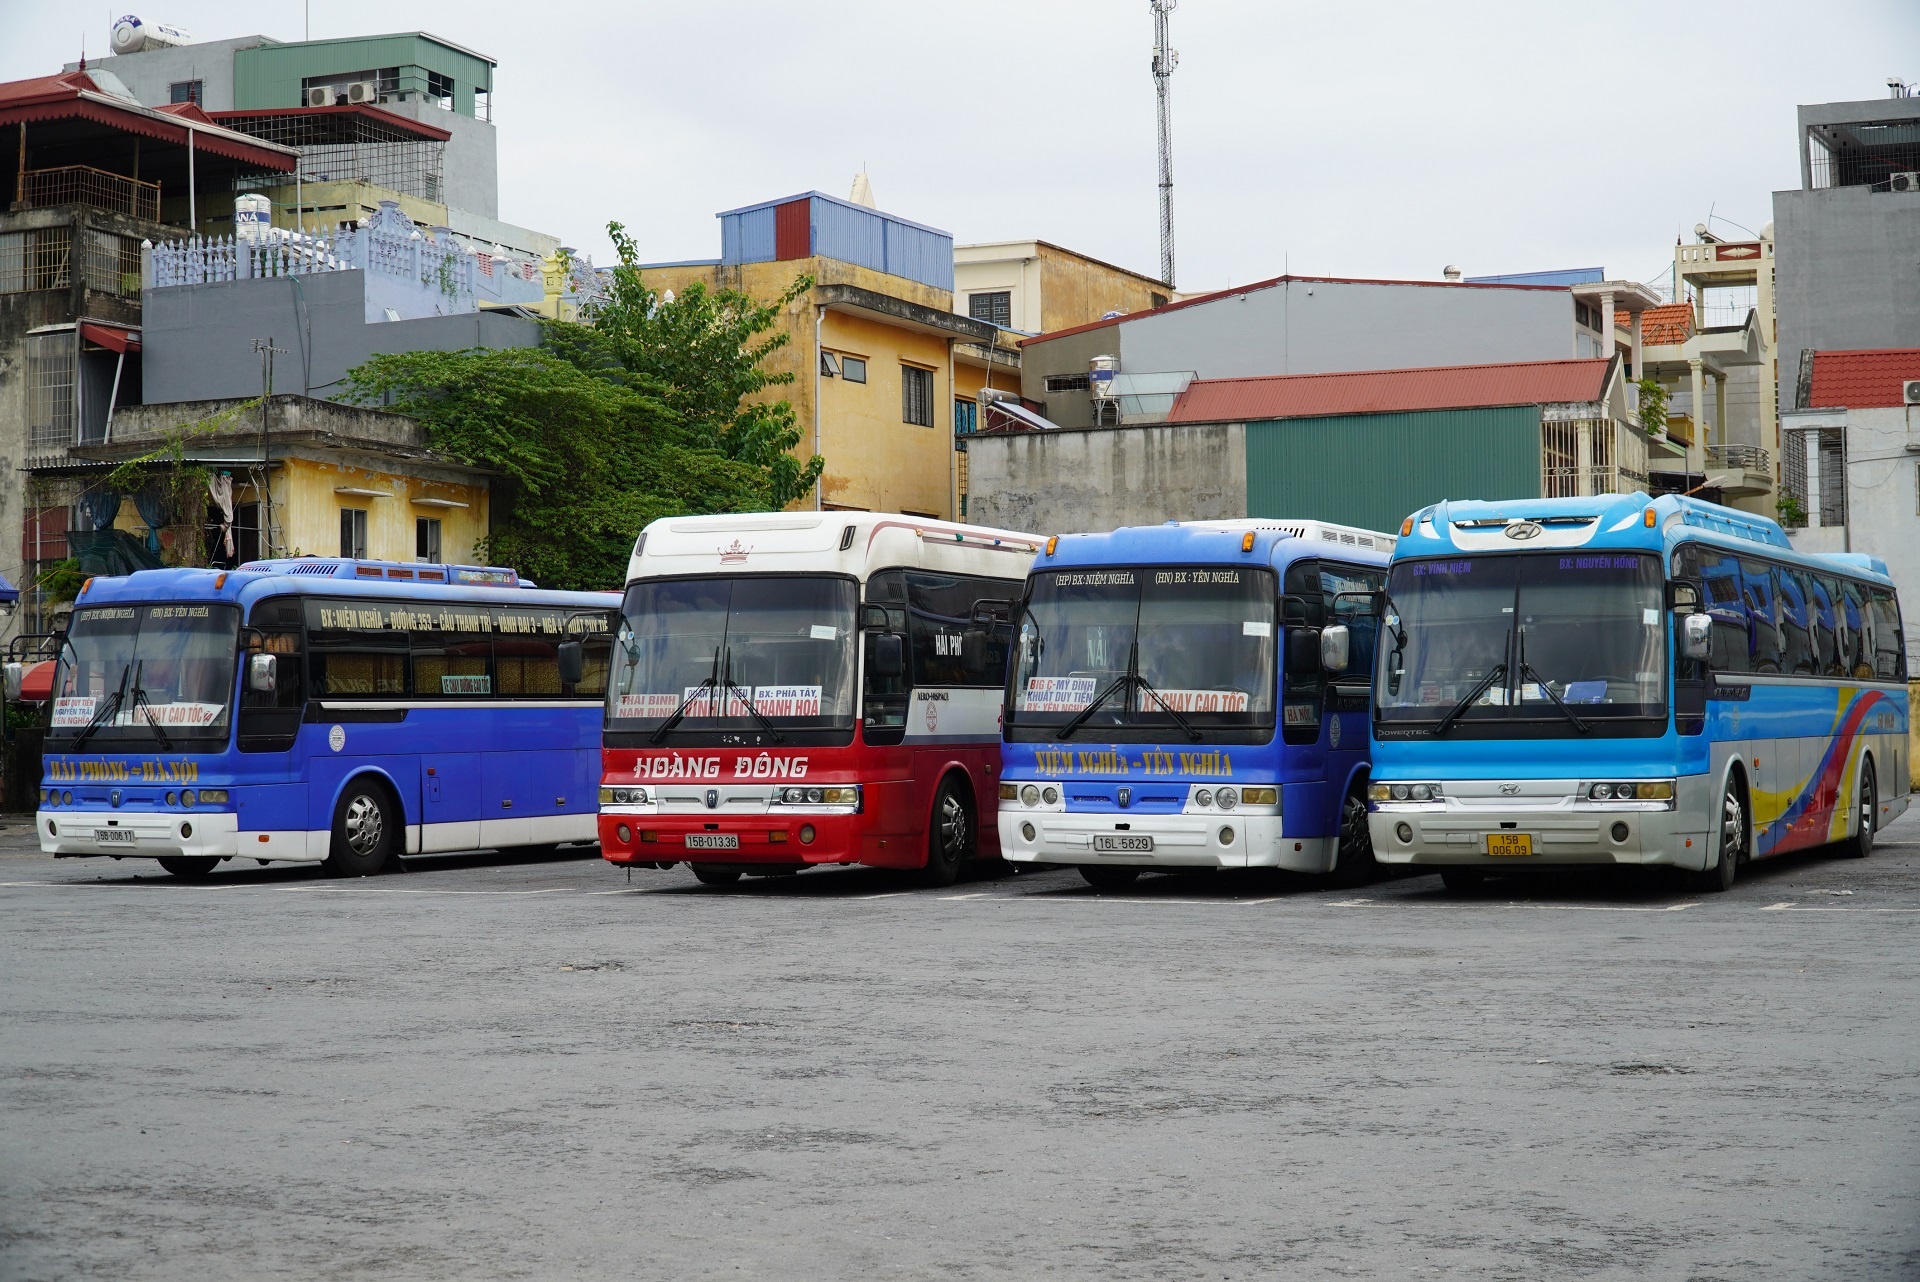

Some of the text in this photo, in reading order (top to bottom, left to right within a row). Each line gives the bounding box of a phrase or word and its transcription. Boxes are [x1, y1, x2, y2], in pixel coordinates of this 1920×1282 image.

[1155, 572, 1173, 584] (HN)
[418, 613, 432, 631] 353
[455, 614, 480, 633] THANH
[1030, 679, 1045, 691] BIG
[1055, 691, 1072, 702] DUY
[1195, 693, 1218, 712] CAO
[168, 706, 186, 723] CAO
[754, 699, 792, 716] THANH
[50, 755, 76, 781] HẢI
[79, 755, 129, 781] PHÒNG
[633, 751, 809, 778] HOÀNG ĐÔNG
[1142, 745, 1175, 776] YÊN
[688, 836, 737, 848] 15B-013.36
[1100, 837, 1148, 850] 16L-5829
[1501, 835, 1519, 845] 15B
[1493, 845, 1527, 855] 006.09
